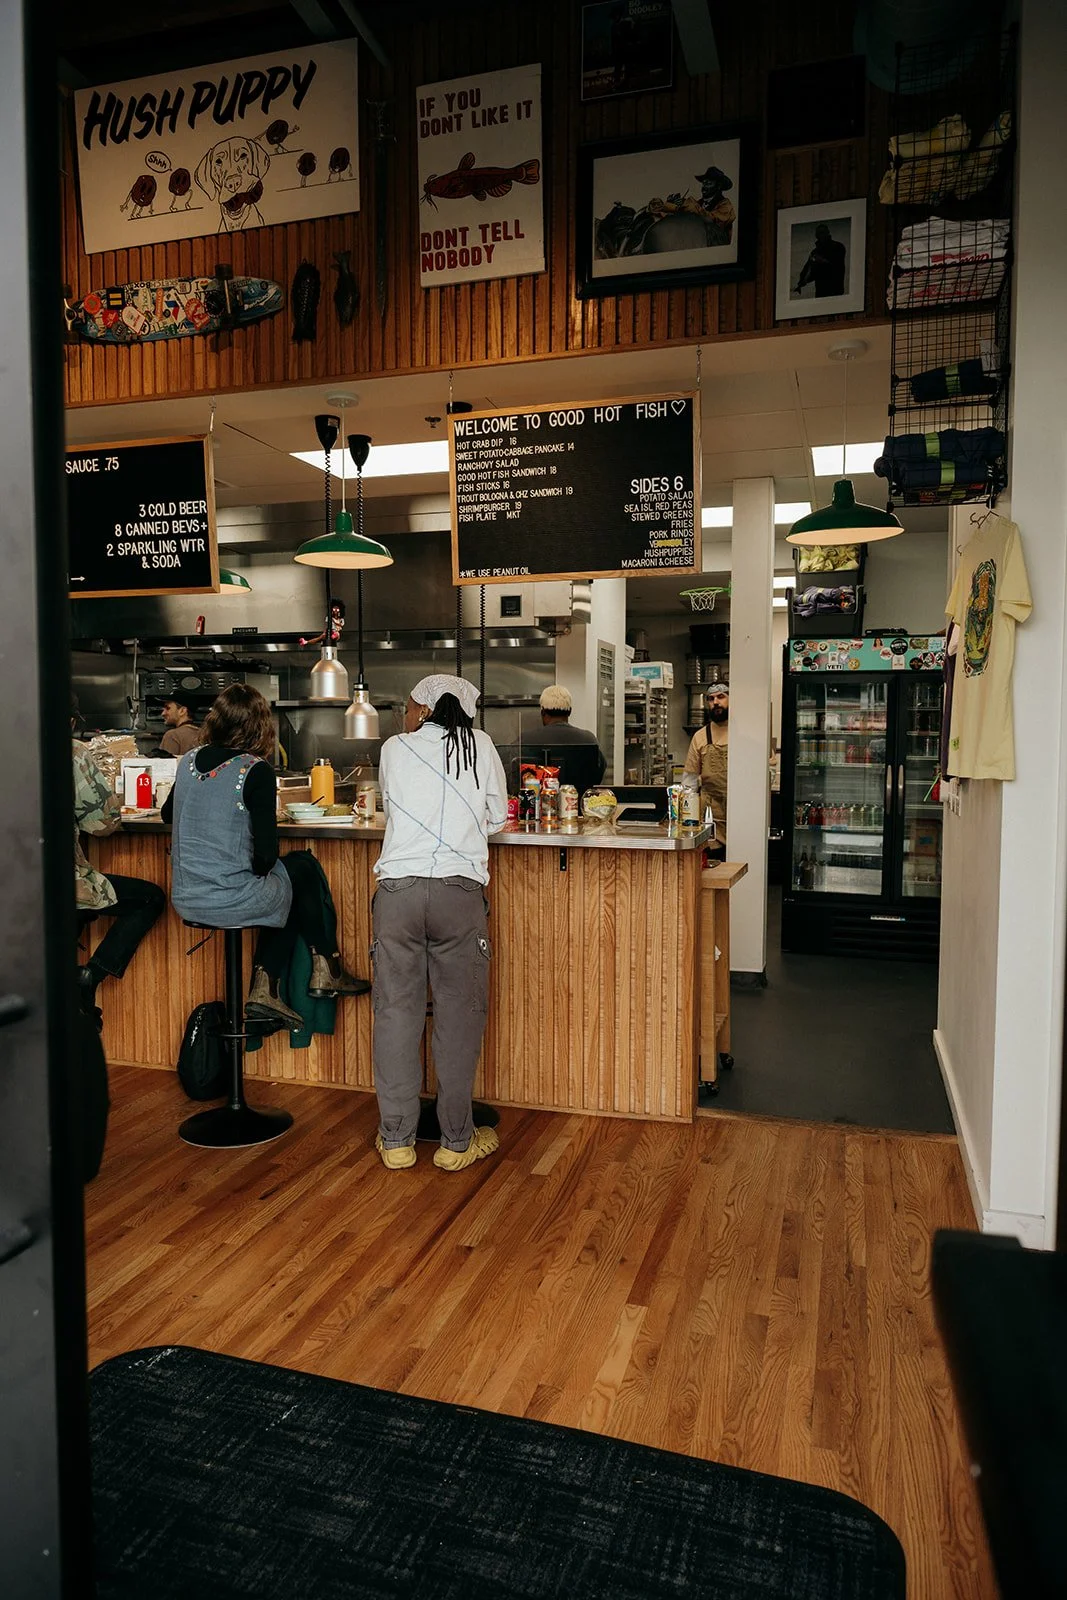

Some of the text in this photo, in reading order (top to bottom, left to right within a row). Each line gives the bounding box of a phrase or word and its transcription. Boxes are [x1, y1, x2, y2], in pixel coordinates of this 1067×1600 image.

[83, 59, 318, 151] HUSH PUPPY
[420, 88, 481, 118] IF YOU
[420, 100, 533, 139] DONT LIKE IT
[149, 154, 168, 169] Shhh
[421, 219, 525, 252] DONT TELL
[421, 244, 496, 273] NOBODY
[454, 401, 667, 436] WELCOME TO GOOD HOT FISH
[457, 437, 517, 450] HOT CRAB DIP 16
[456, 451, 477, 461] SWEET
[535, 443, 564, 454] PANCAKE
[568, 442, 574, 450] 14
[65, 457, 119, 474] SAUCE .75
[458, 458, 519, 471] RANCHOVY SALAD
[458, 466, 557, 482] GOOD HOT FISH SANDWICH 18
[458, 481, 510, 492] FISH STICKS 16
[630, 476, 683, 494] SIDES 6
[457, 494, 478, 503] TROUT
[479, 491, 509, 502] BOLOGNA
[516, 490, 528, 499] CHZ
[530, 488, 562, 497] SANDWICH
[566, 487, 574, 495] 19
[640, 491, 693, 502] POTATO SALAD
[139, 500, 207, 517] 3 COLD BEER
[459, 502, 522, 514] SHRIMPBURGER 19
[624, 501, 693, 512] SEA ISL RED PEAS
[459, 511, 521, 523] FISH PLATE MKT
[631, 510, 693, 521] STEWED GREENS
[115, 524, 122, 537] 8
[126, 521, 168, 536] CANNED
[671, 520, 693, 528] FRIES
[649, 529, 694, 539] PORK RINDS
[107, 538, 205, 557] 2 SPARKLING WTR
[644, 547, 693, 558] HUSHPUPPIES
[141, 554, 181, 568] & SODA
[622, 556, 693, 569] MACARONI & CHEESE
[478, 569, 491, 577] USE
[493, 567, 519, 576] PEANUT
[520, 566, 531, 574] OIL
[139, 778, 149, 786] 13
